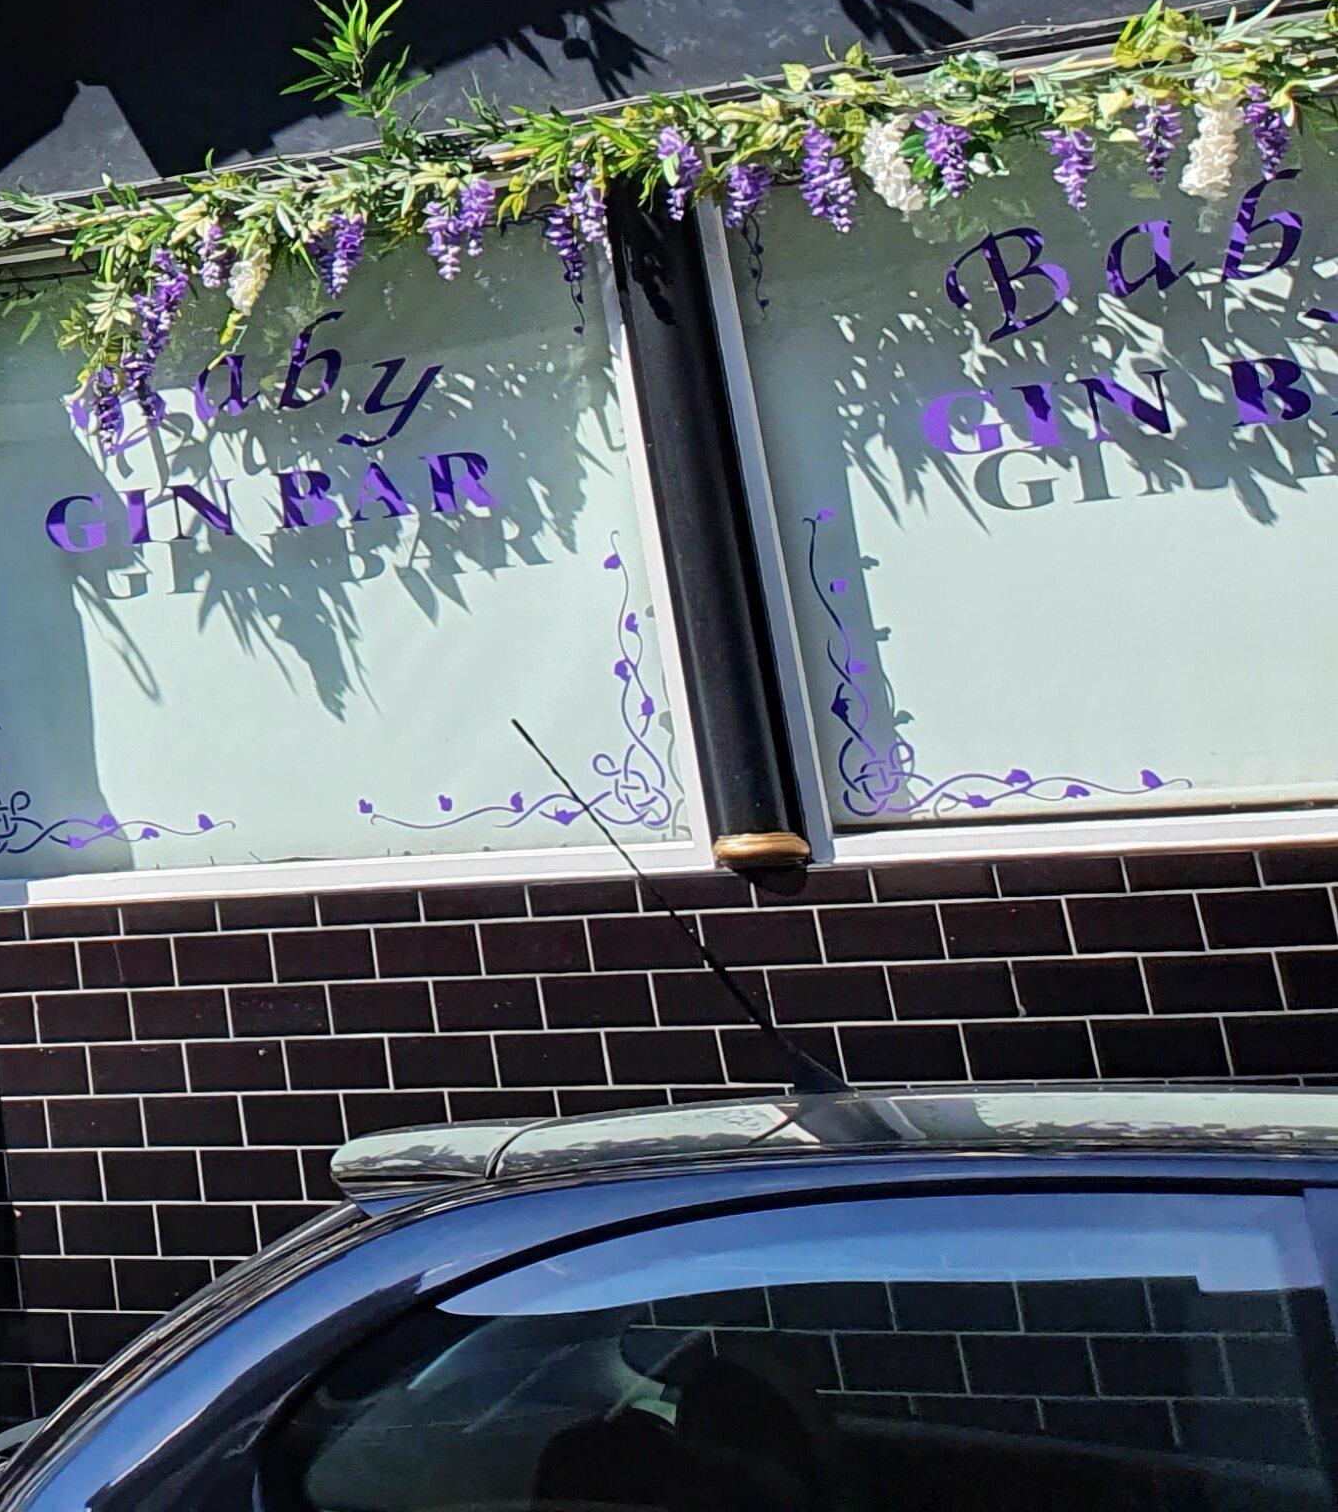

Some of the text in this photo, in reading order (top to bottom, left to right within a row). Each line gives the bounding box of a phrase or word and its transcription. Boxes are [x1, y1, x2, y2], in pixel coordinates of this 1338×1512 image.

[945, 169, 1338, 341] Bab
[923, 369, 1173, 455] GIN
[45, 451, 498, 553] GIN BAR
